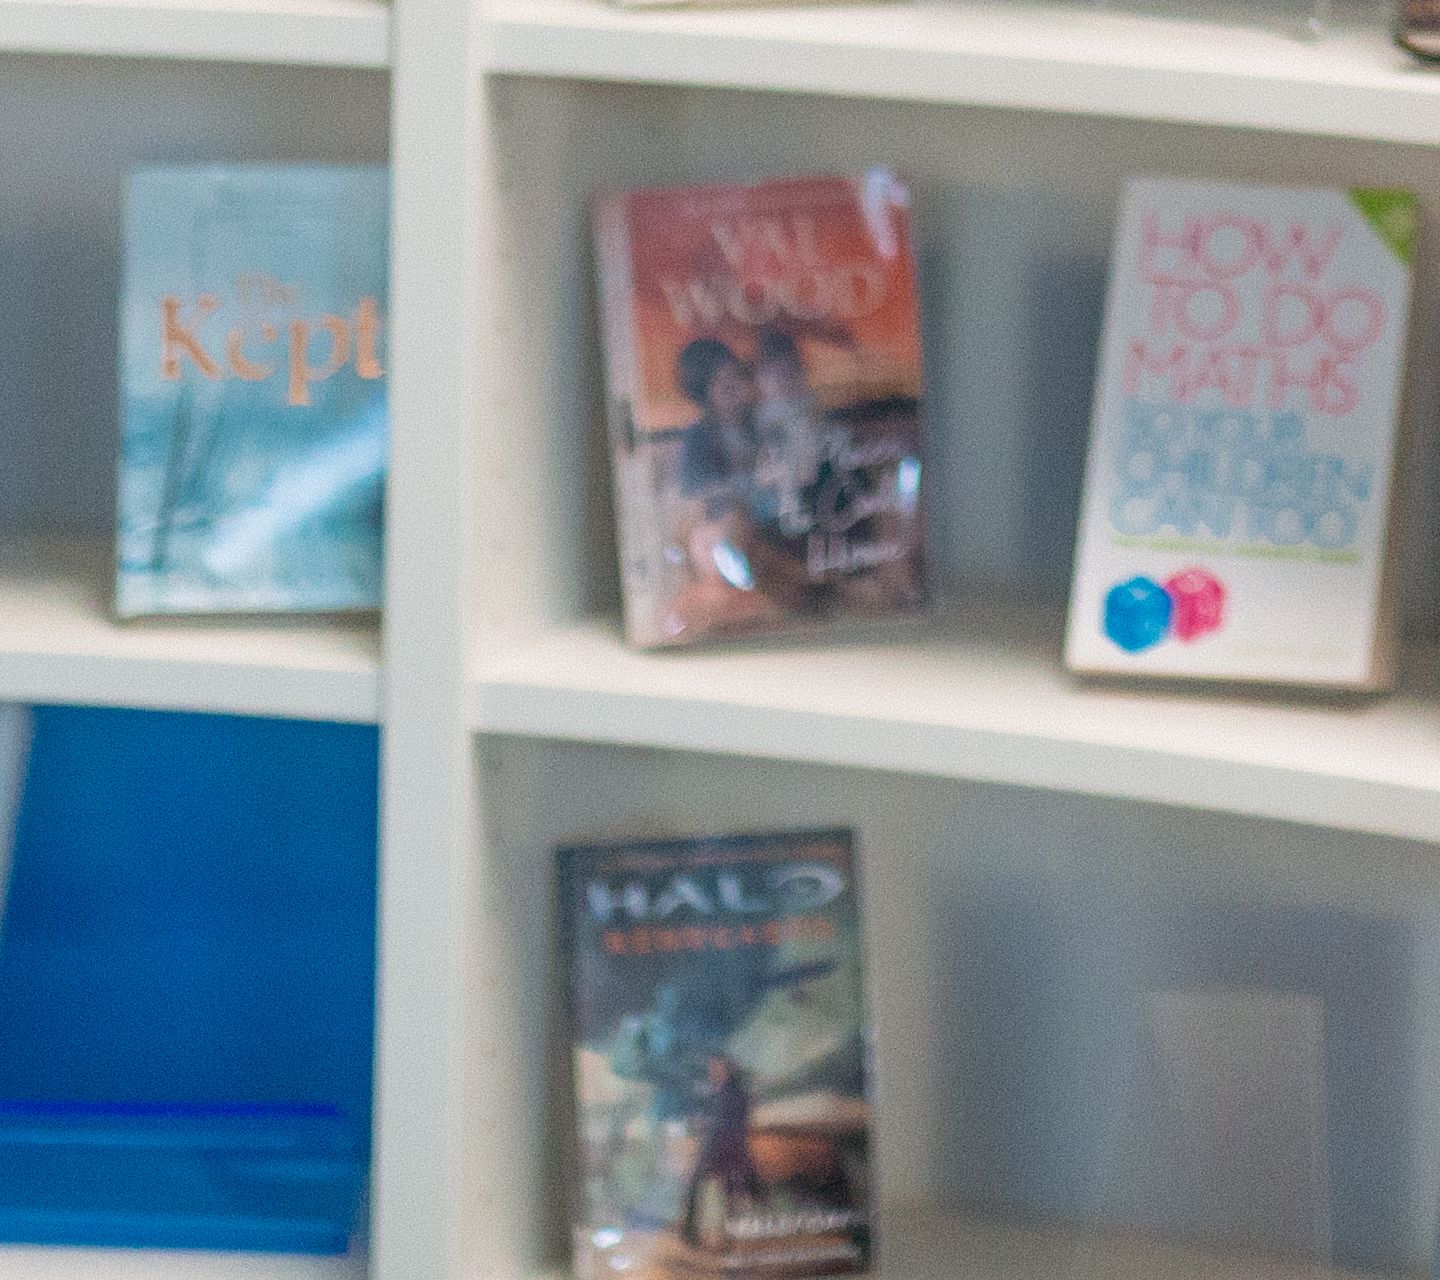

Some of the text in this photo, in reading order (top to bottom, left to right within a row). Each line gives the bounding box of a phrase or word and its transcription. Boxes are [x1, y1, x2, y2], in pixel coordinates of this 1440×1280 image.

[1140, 206, 1346, 283] HOW
[160, 293, 385, 407] Kept
[1146, 272, 1387, 352] TO DO
[1120, 337, 1362, 417] MATHS
[586, 862, 847, 923] HALO
